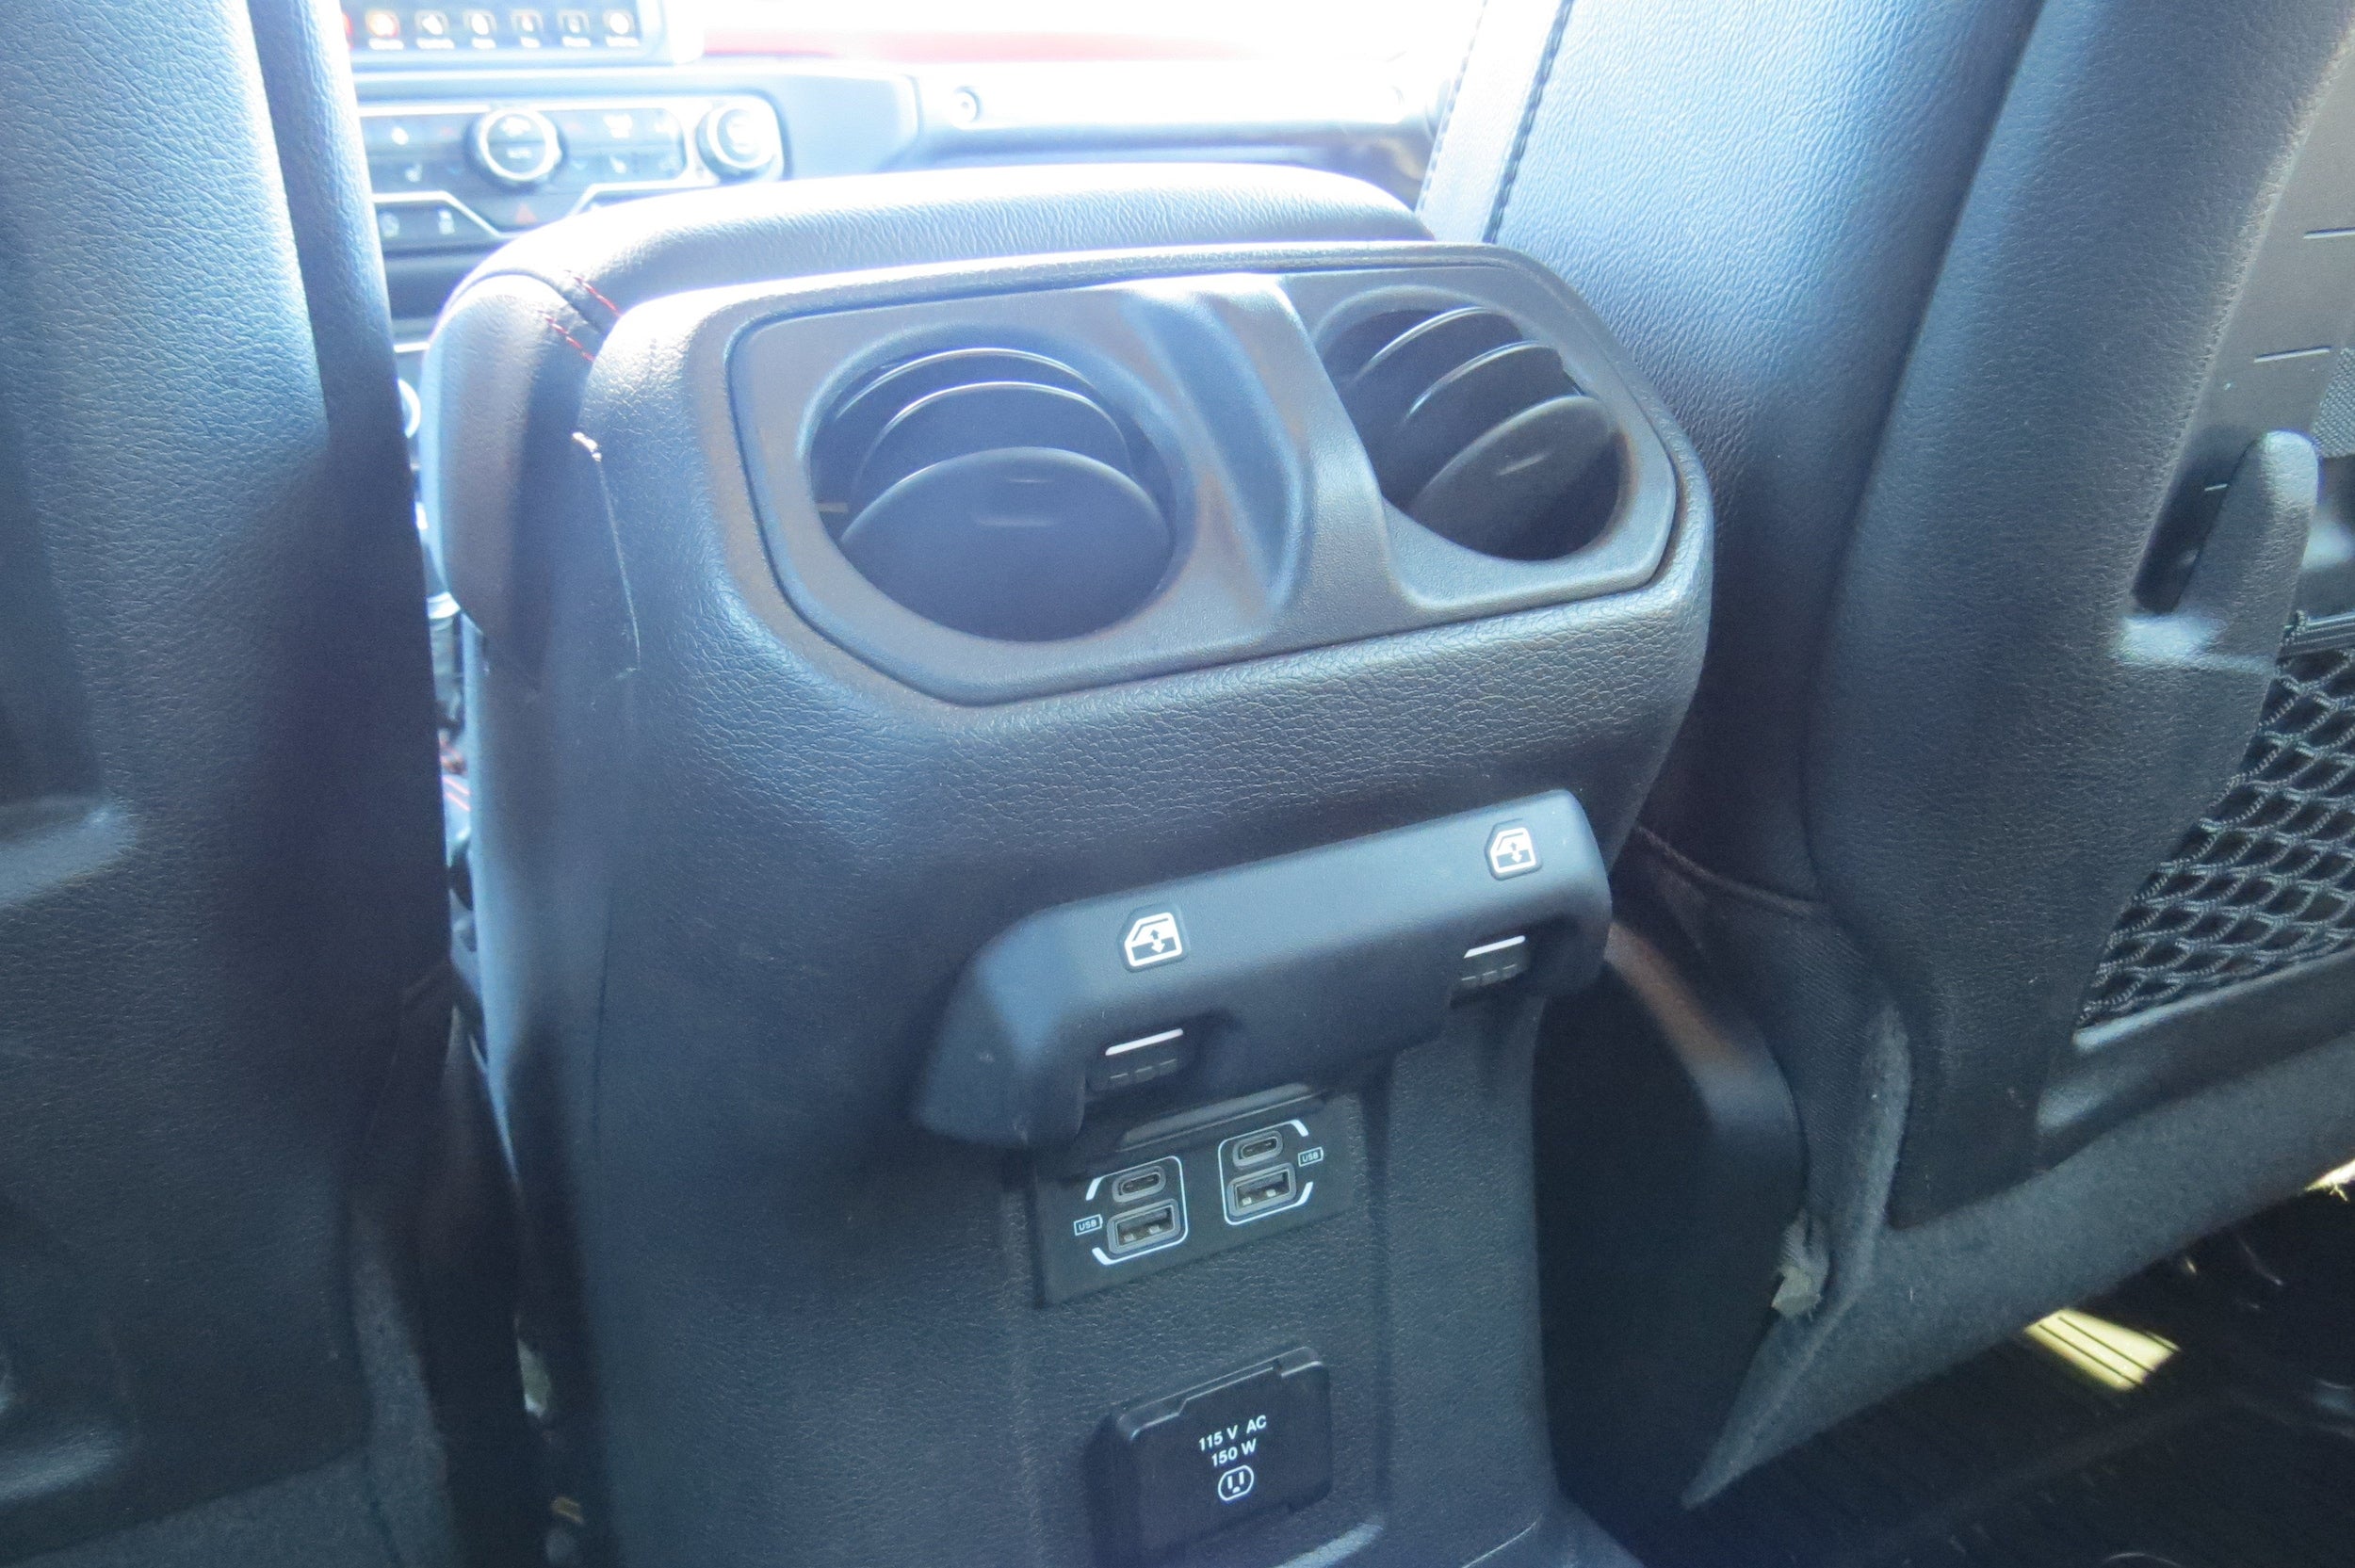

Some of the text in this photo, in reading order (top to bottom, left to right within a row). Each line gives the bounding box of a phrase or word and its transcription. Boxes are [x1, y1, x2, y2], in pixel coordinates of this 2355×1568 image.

[1302, 1151, 1319, 1163] USB
[1078, 1219, 1097, 1232] USB
[1198, 1414, 1267, 1451] 115 V AC
[1211, 1438, 1257, 1466] 150 W
